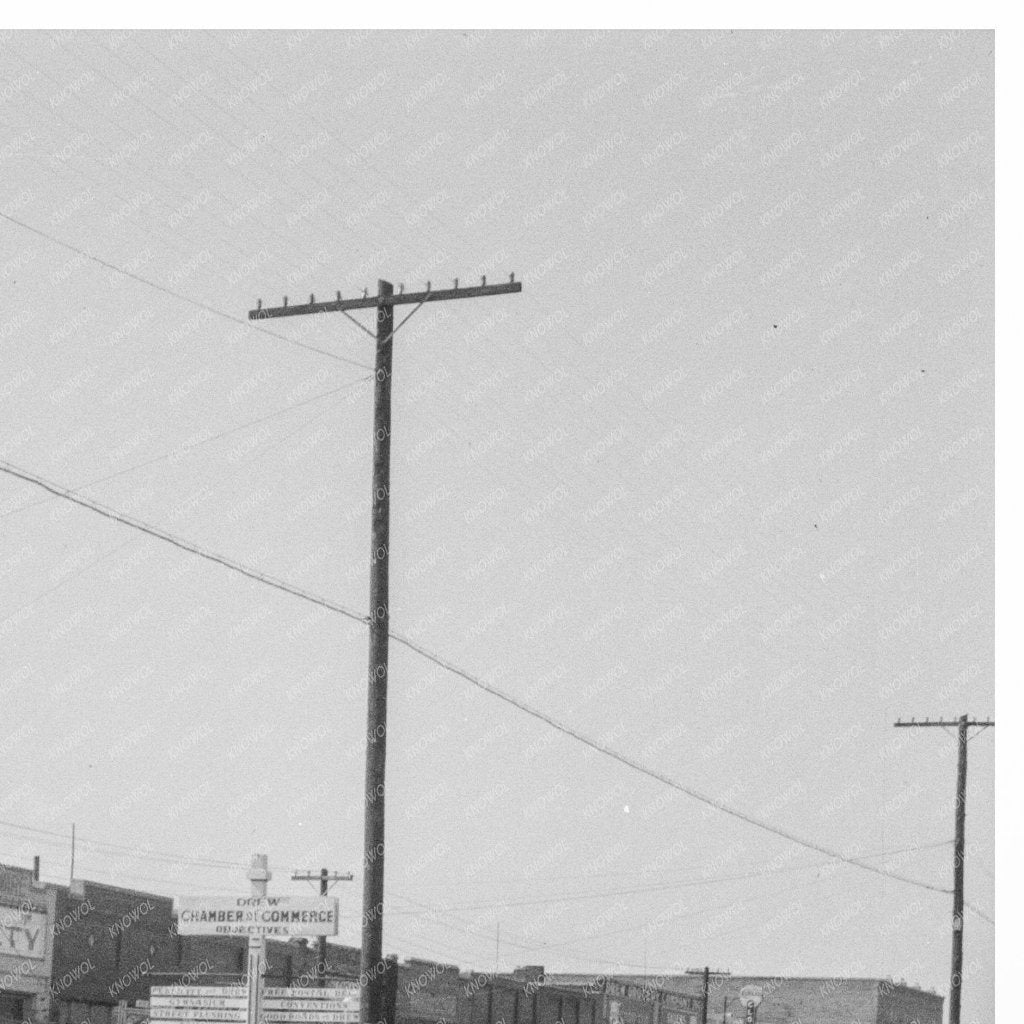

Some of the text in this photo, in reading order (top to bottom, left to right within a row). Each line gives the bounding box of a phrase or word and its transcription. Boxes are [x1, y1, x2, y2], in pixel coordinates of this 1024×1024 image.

[237, 898, 281, 906] DREW
[181, 910, 243, 922] CHAMBER
[262, 910, 334, 923] COMMERCE
[216, 925, 289, 934] OBJECTIVES
